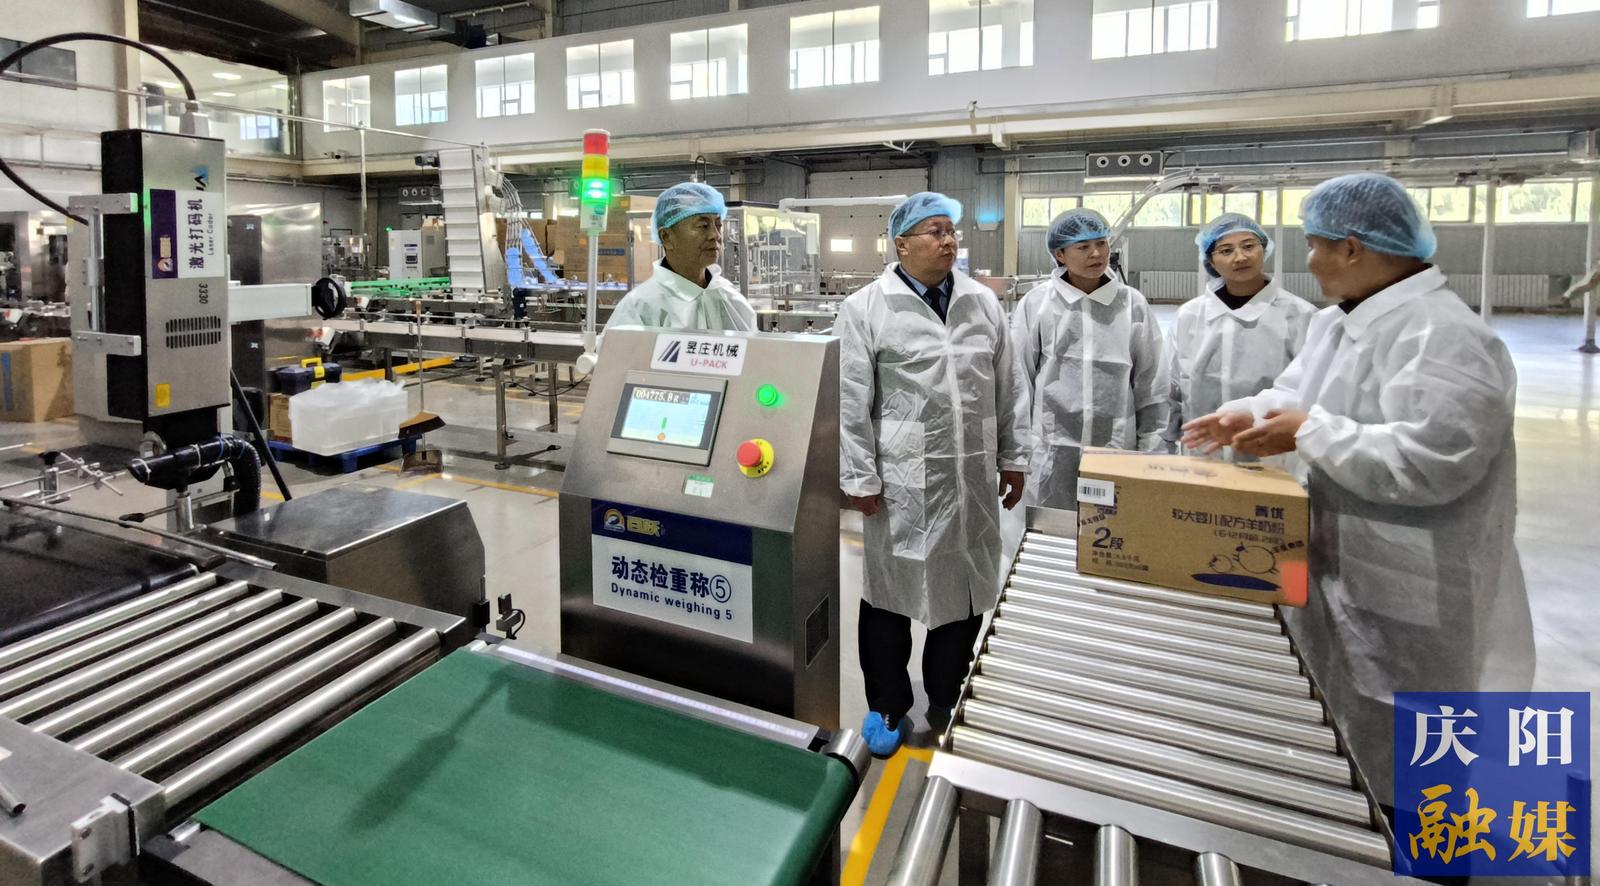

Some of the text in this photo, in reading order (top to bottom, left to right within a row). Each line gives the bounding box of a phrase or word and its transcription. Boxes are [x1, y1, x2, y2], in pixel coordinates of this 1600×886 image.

[187, 199, 204, 269] 激光打码机
[198, 282, 208, 304] 3330
[686, 341, 739, 357] 昱庄机械
[690, 358, 728, 369] U-PACK
[1171, 508, 1285, 535] 较大婴儿配方羊奶粉
[1092, 526, 1124, 550] 2段
[611, 582, 733, 620] Dynamic weighing 5
